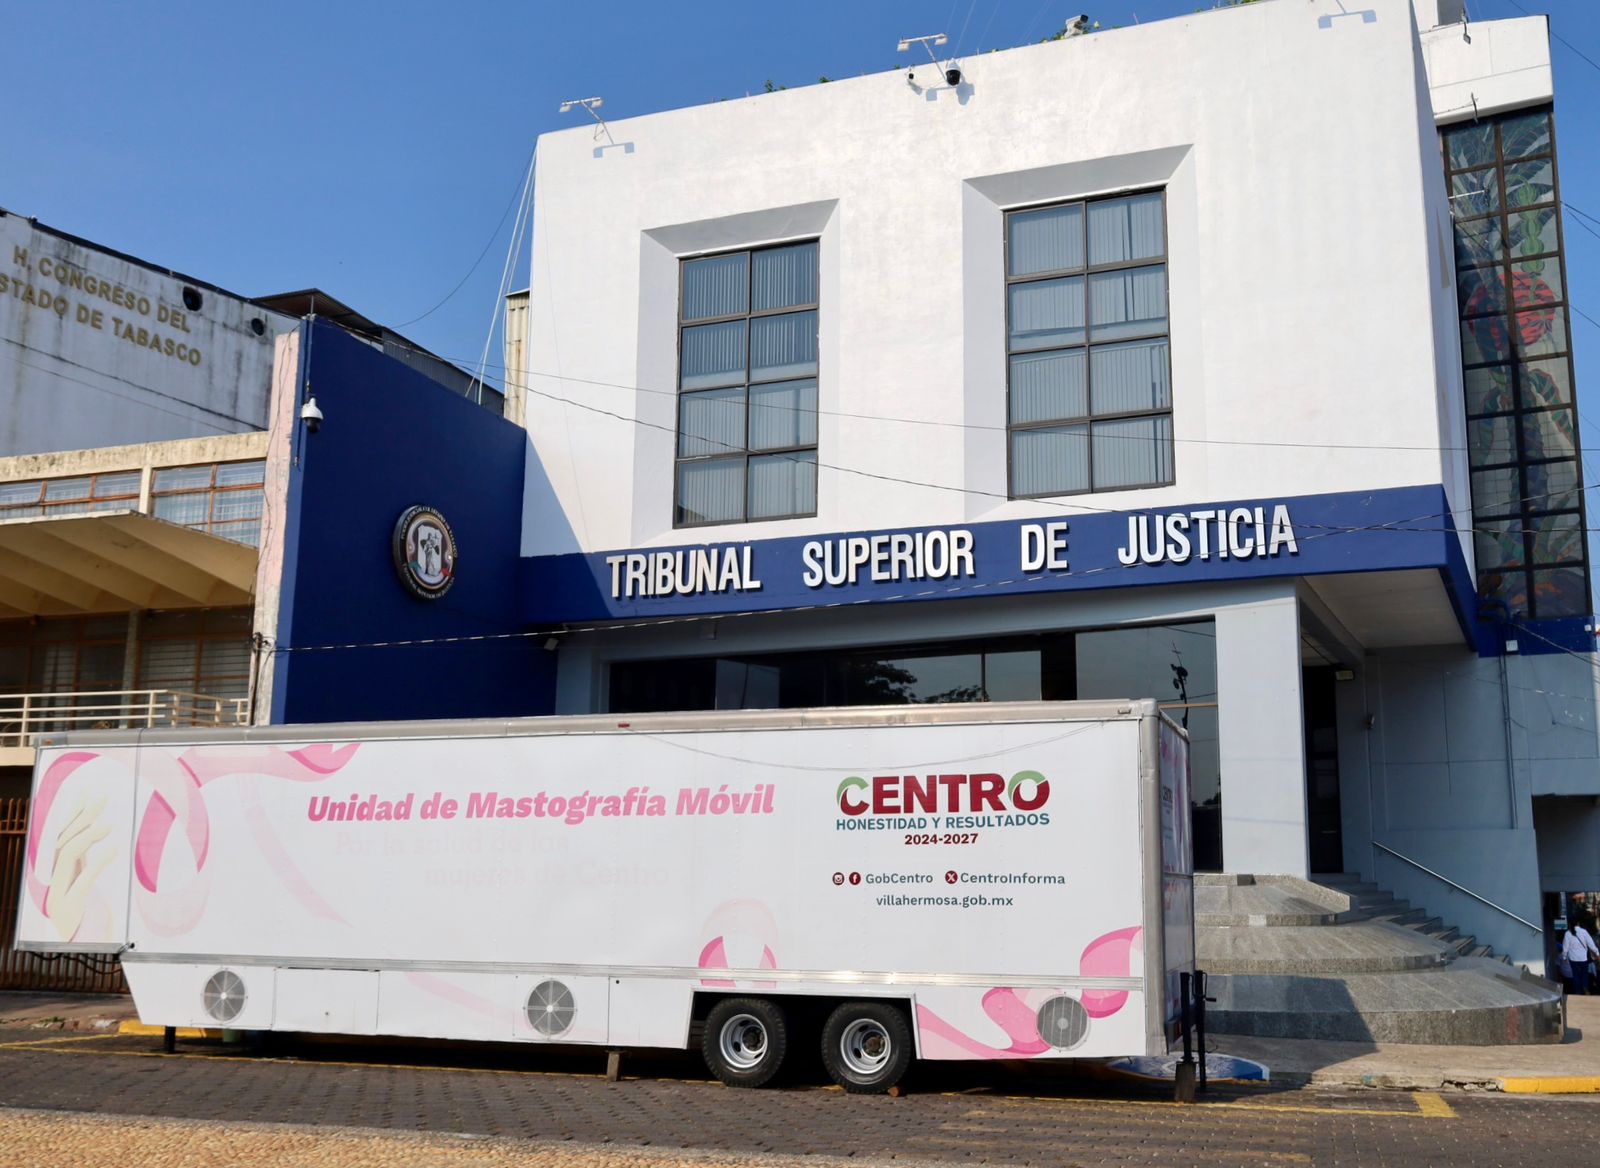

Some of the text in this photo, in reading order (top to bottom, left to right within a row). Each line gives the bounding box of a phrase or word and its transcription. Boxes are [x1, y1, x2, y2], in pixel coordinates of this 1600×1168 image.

[13, 245, 191, 333] H. CONGRESO DEL
[76, 302, 104, 331] DE
[111, 316, 202, 367] TABASCO
[606, 504, 1299, 598] TRIBUNAL SUPERIOR DE JUSTICIA
[307, 783, 776, 826] Unidad de Mastografía Móvil
[836, 770, 1051, 816] CENTRO
[836, 813, 1050, 831] HONESTIDAD Y RESULTADOS
[904, 833, 979, 846] 2024-2027
[865, 872, 1066, 885] GobCentro CentroInforma
[876, 894, 1014, 908] villahermosa.gob.mx
